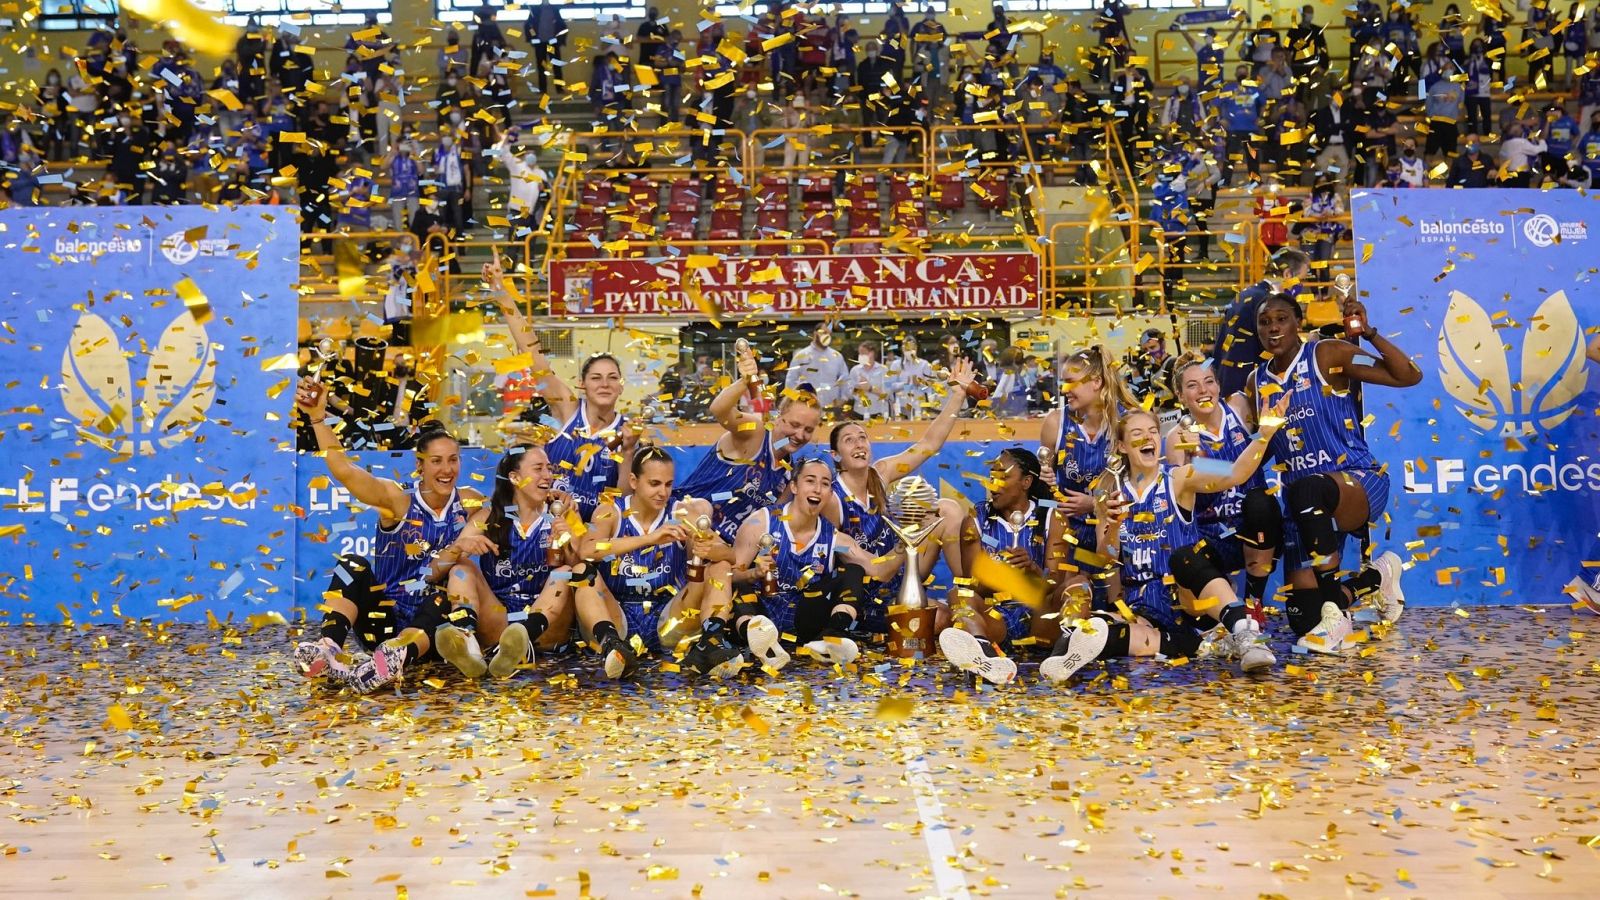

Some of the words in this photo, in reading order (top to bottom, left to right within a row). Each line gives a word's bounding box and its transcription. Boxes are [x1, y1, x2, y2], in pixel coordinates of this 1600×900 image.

[1420, 219, 1505, 235] baloncesto
[1421, 235, 1457, 243] ESPAÑA
[604, 290, 773, 312] PATRIMONI
[867, 285, 1028, 309] HUMANIDAD
[1404, 459, 1464, 494] LF
[18, 478, 79, 512] LF
[310, 487, 350, 510] LF
